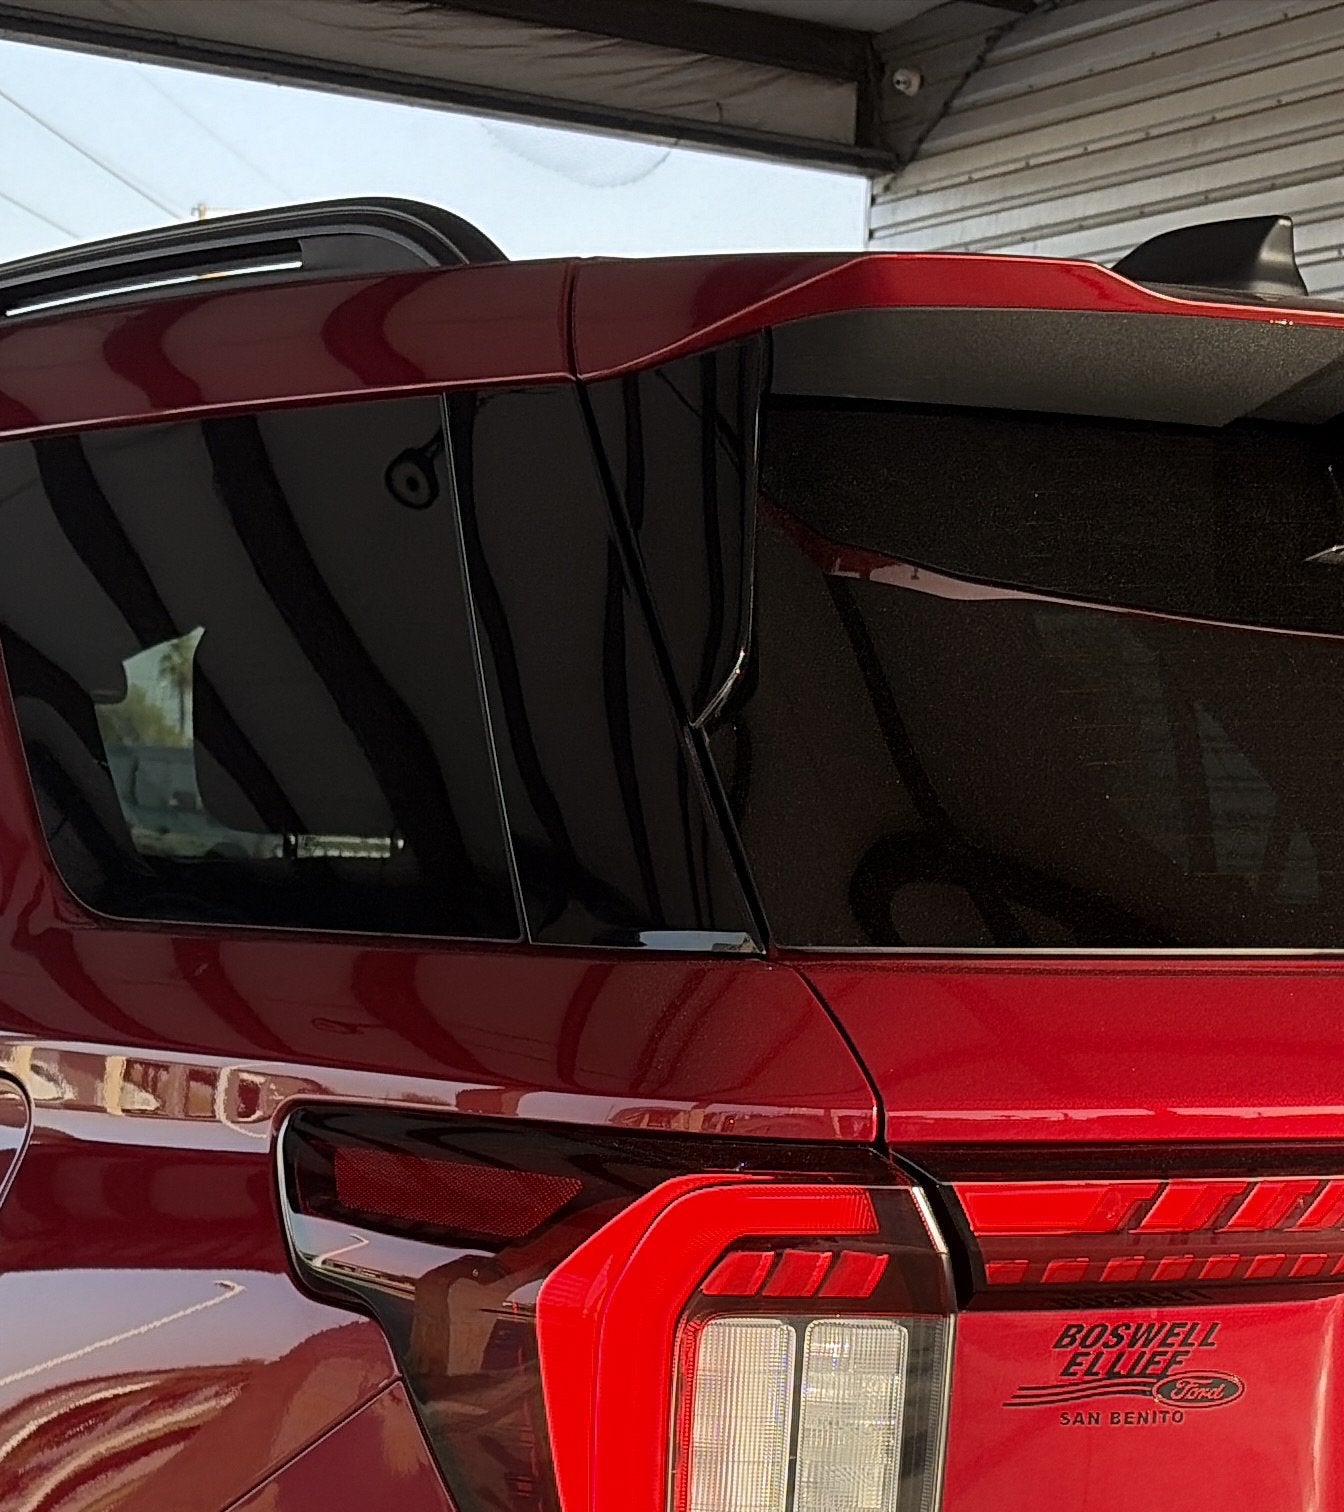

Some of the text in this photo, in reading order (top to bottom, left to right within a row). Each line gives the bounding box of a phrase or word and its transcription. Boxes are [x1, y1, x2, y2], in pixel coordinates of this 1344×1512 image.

[1052, 1321, 1220, 1349] BOSWELL
[1059, 1350, 1191, 1378] ELLIFF
[1170, 1378, 1225, 1401] Ford
[1059, 1410, 1184, 1426] SAN BENITO
